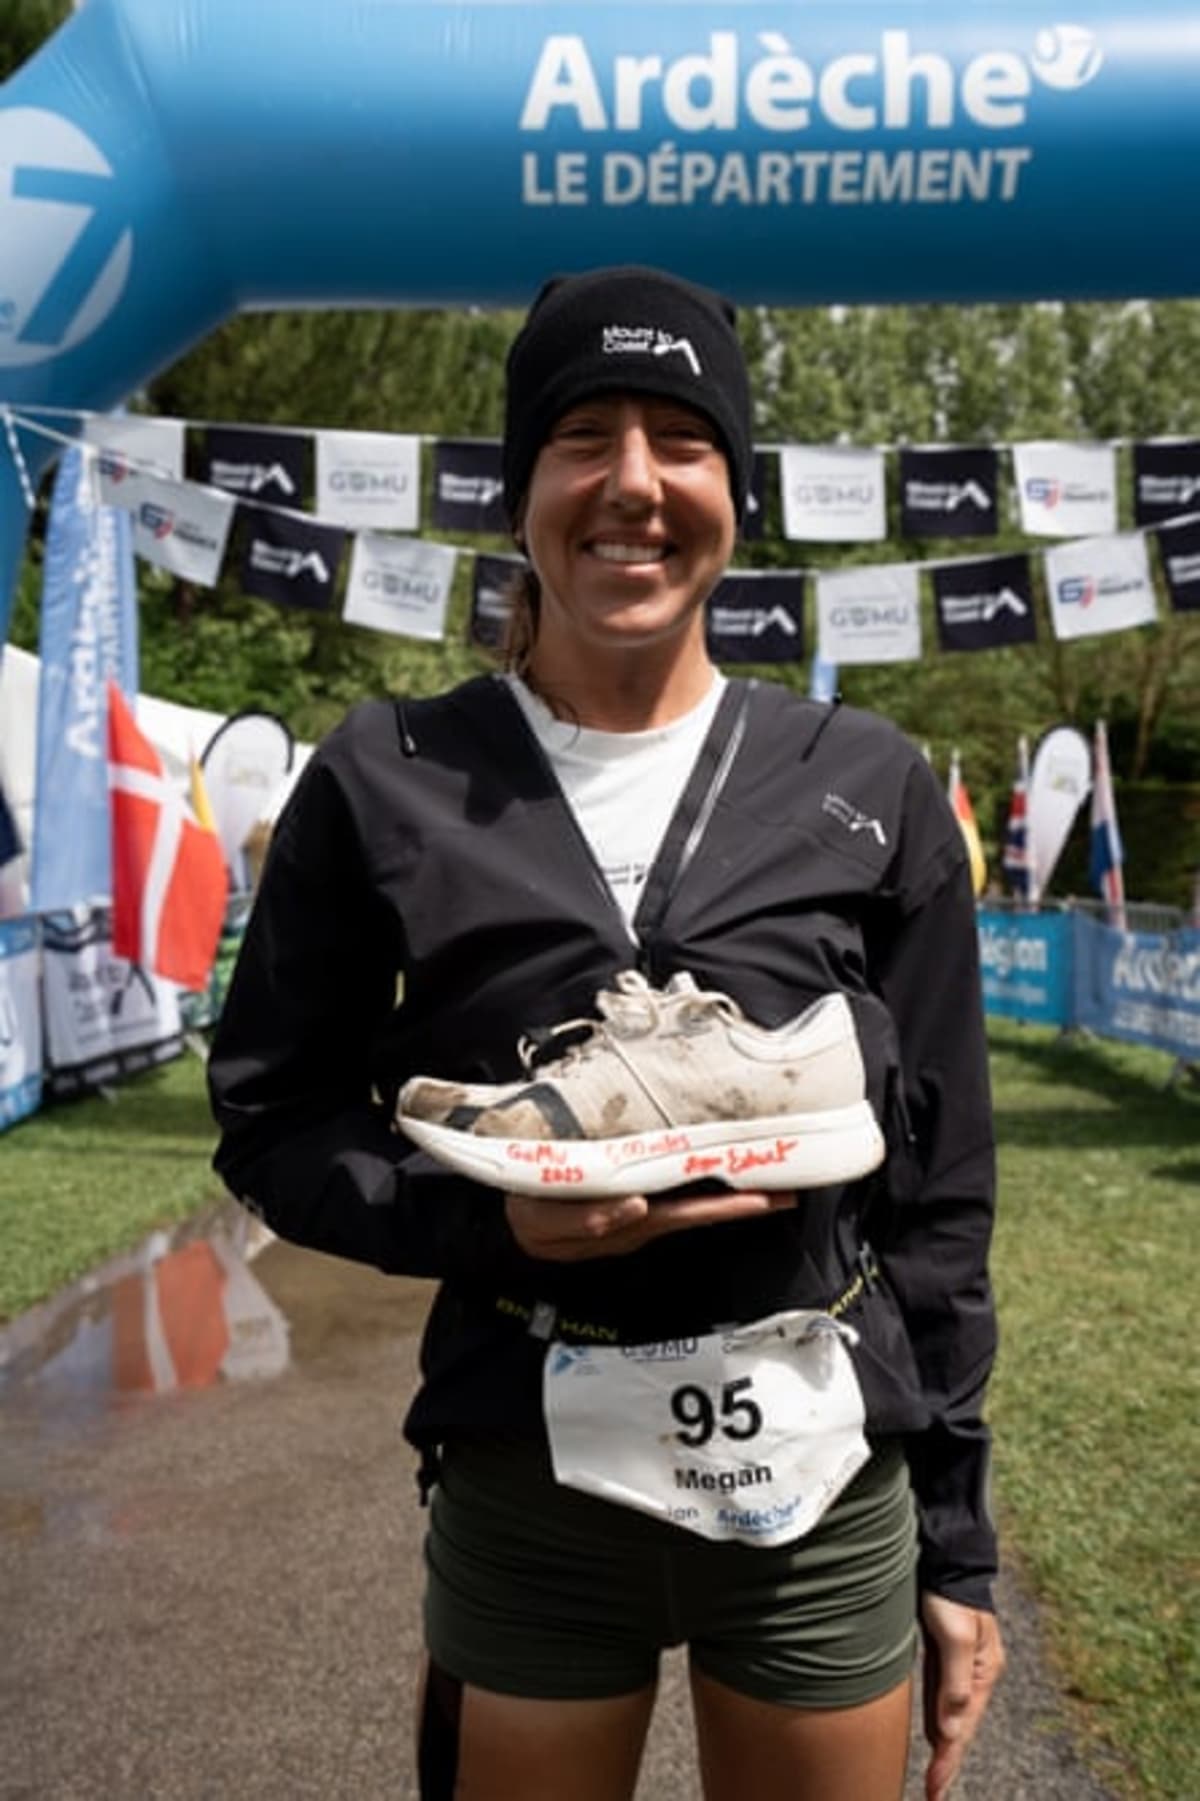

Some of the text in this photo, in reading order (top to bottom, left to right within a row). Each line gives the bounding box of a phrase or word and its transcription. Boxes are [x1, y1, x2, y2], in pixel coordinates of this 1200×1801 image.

[519, 29, 1032, 132] Ardèche
[521, 142, 1032, 205] LE DÉPARTEMENT
[671, 1376, 763, 1448] 95
[674, 1465, 773, 1494] Megan
